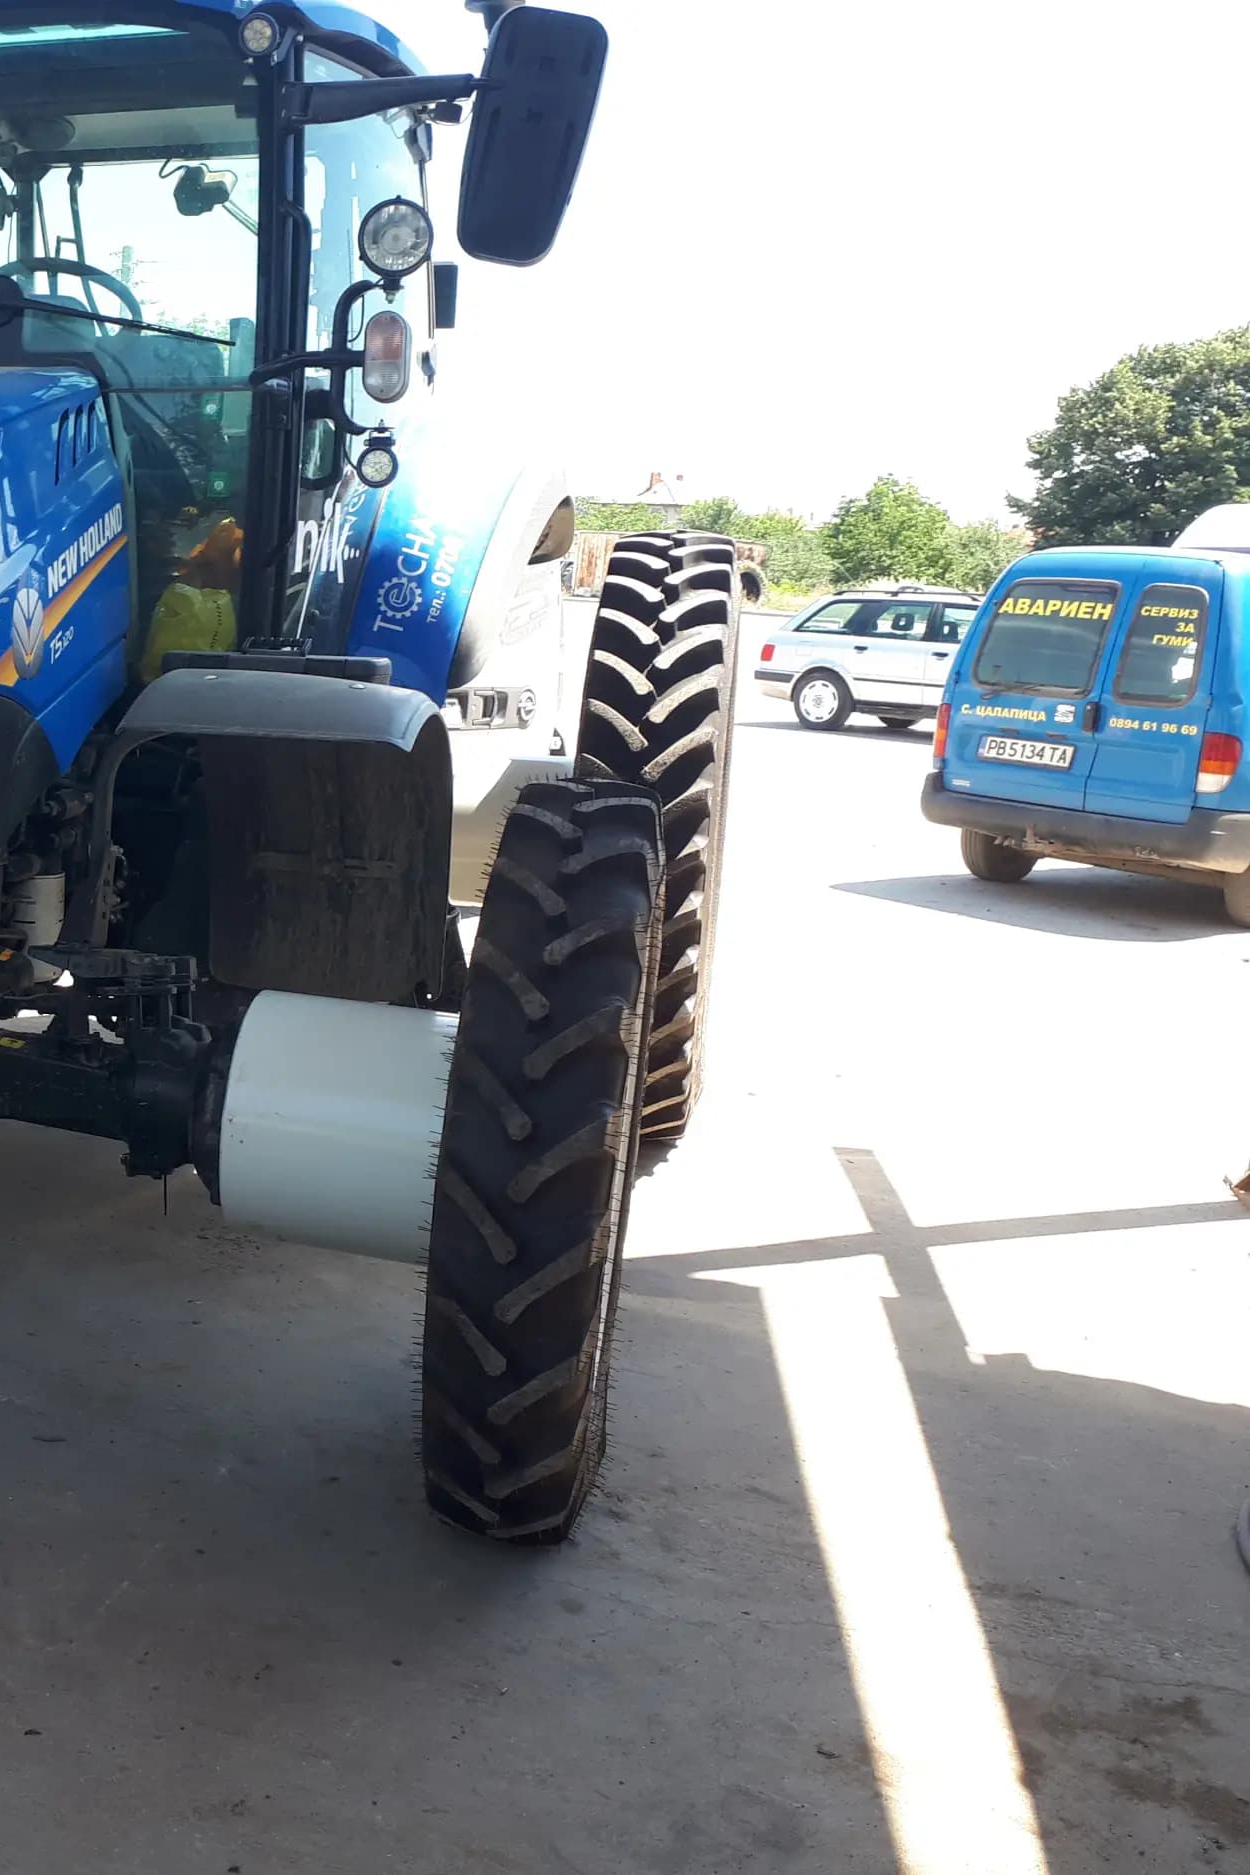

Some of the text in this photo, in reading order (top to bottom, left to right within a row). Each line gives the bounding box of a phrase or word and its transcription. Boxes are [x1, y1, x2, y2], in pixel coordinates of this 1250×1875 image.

[47, 503, 123, 599] NEW HOLLAND
[998, 597, 1114, 621] АВАРИЕН
[1141, 606, 1199, 620] СЕРВИЗ
[1175, 622, 1195, 633] ЗА
[1152, 634, 1194, 647] ГУМИ
[1109, 717, 1140, 730] 0894
[1180, 724, 1198, 736] 69
